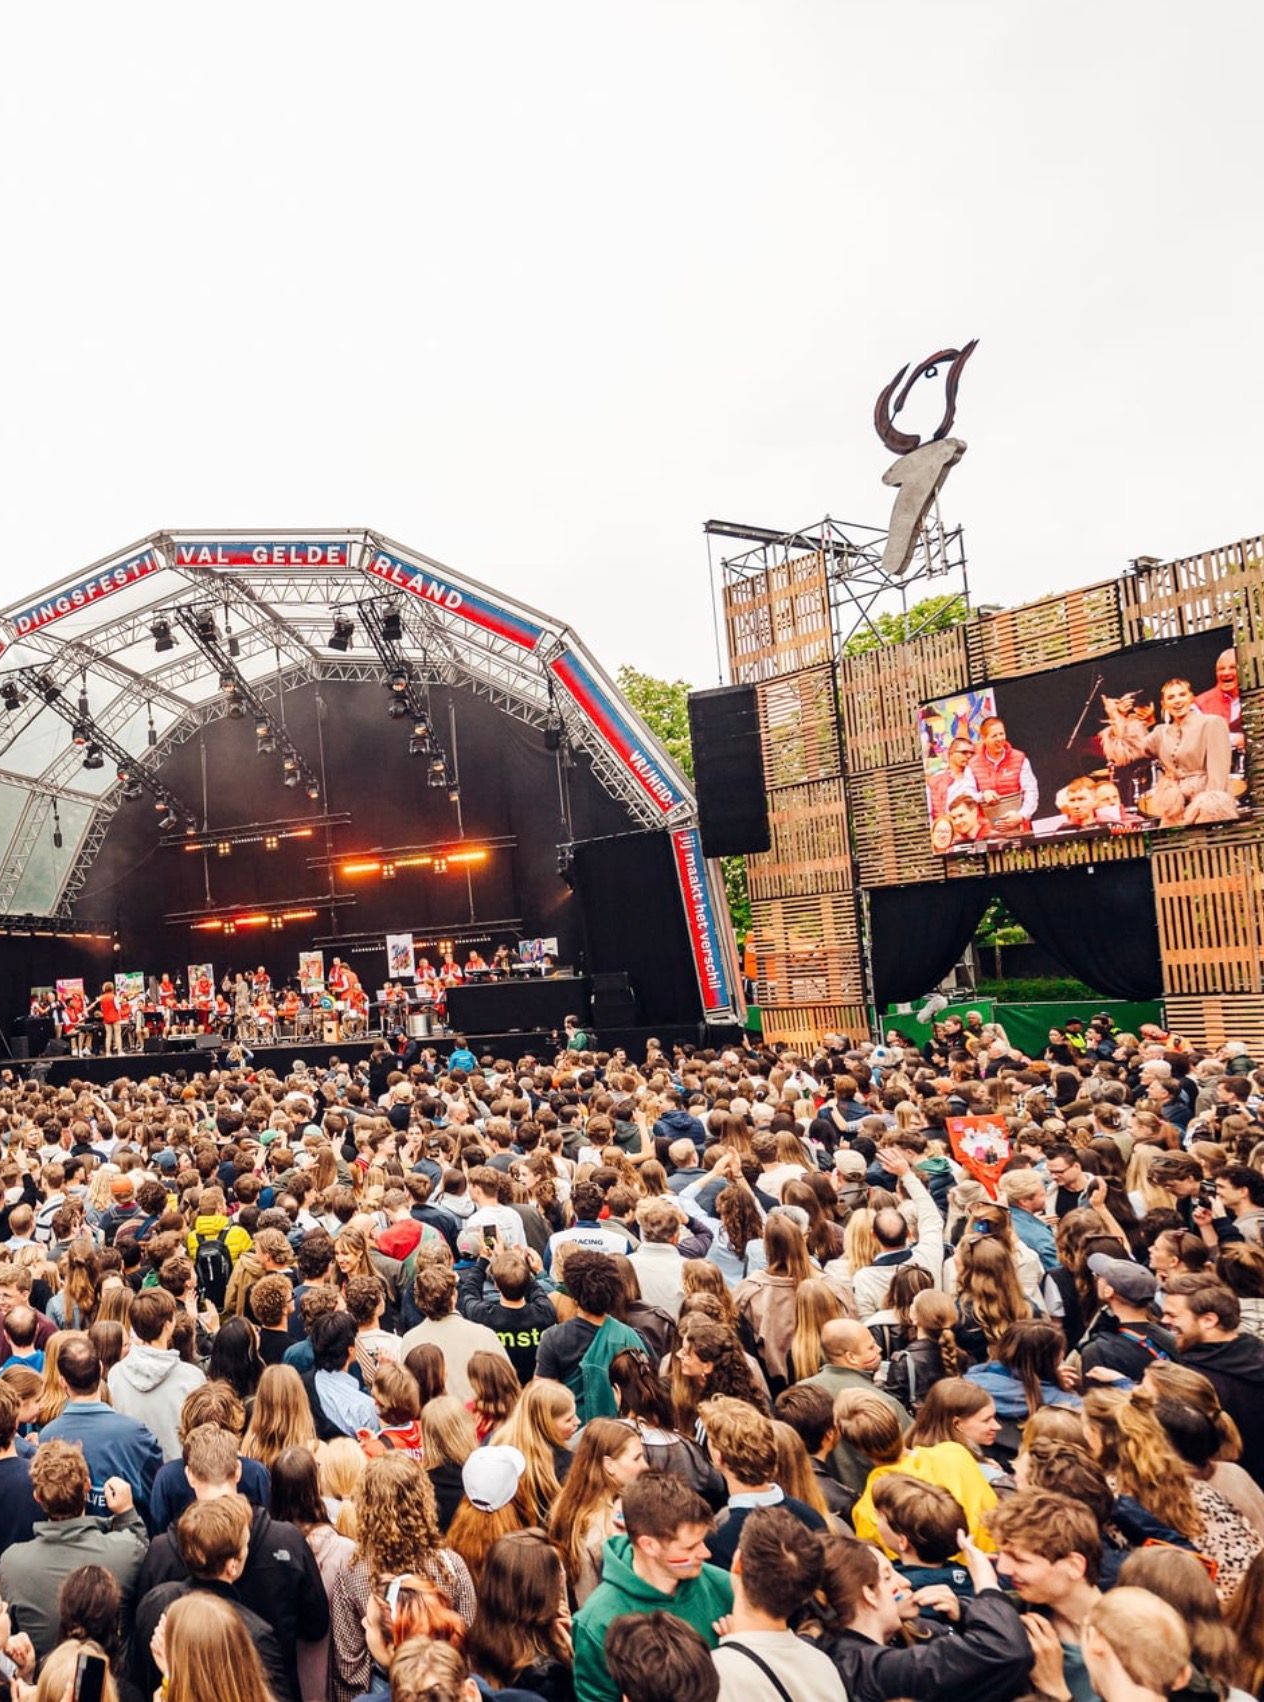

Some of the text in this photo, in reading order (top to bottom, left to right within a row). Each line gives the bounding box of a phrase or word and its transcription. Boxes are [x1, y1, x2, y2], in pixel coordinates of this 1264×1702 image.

[17, 555, 154, 632] DINGSFESTI
[181, 546, 229, 563] VAL
[252, 546, 340, 563] GELDE
[373, 555, 463, 609] RLAND
[685, 854, 704, 901] maakt
[694, 903, 709, 930] het
[699, 933, 722, 989] verschil
[496, 1328, 544, 1347] mst
